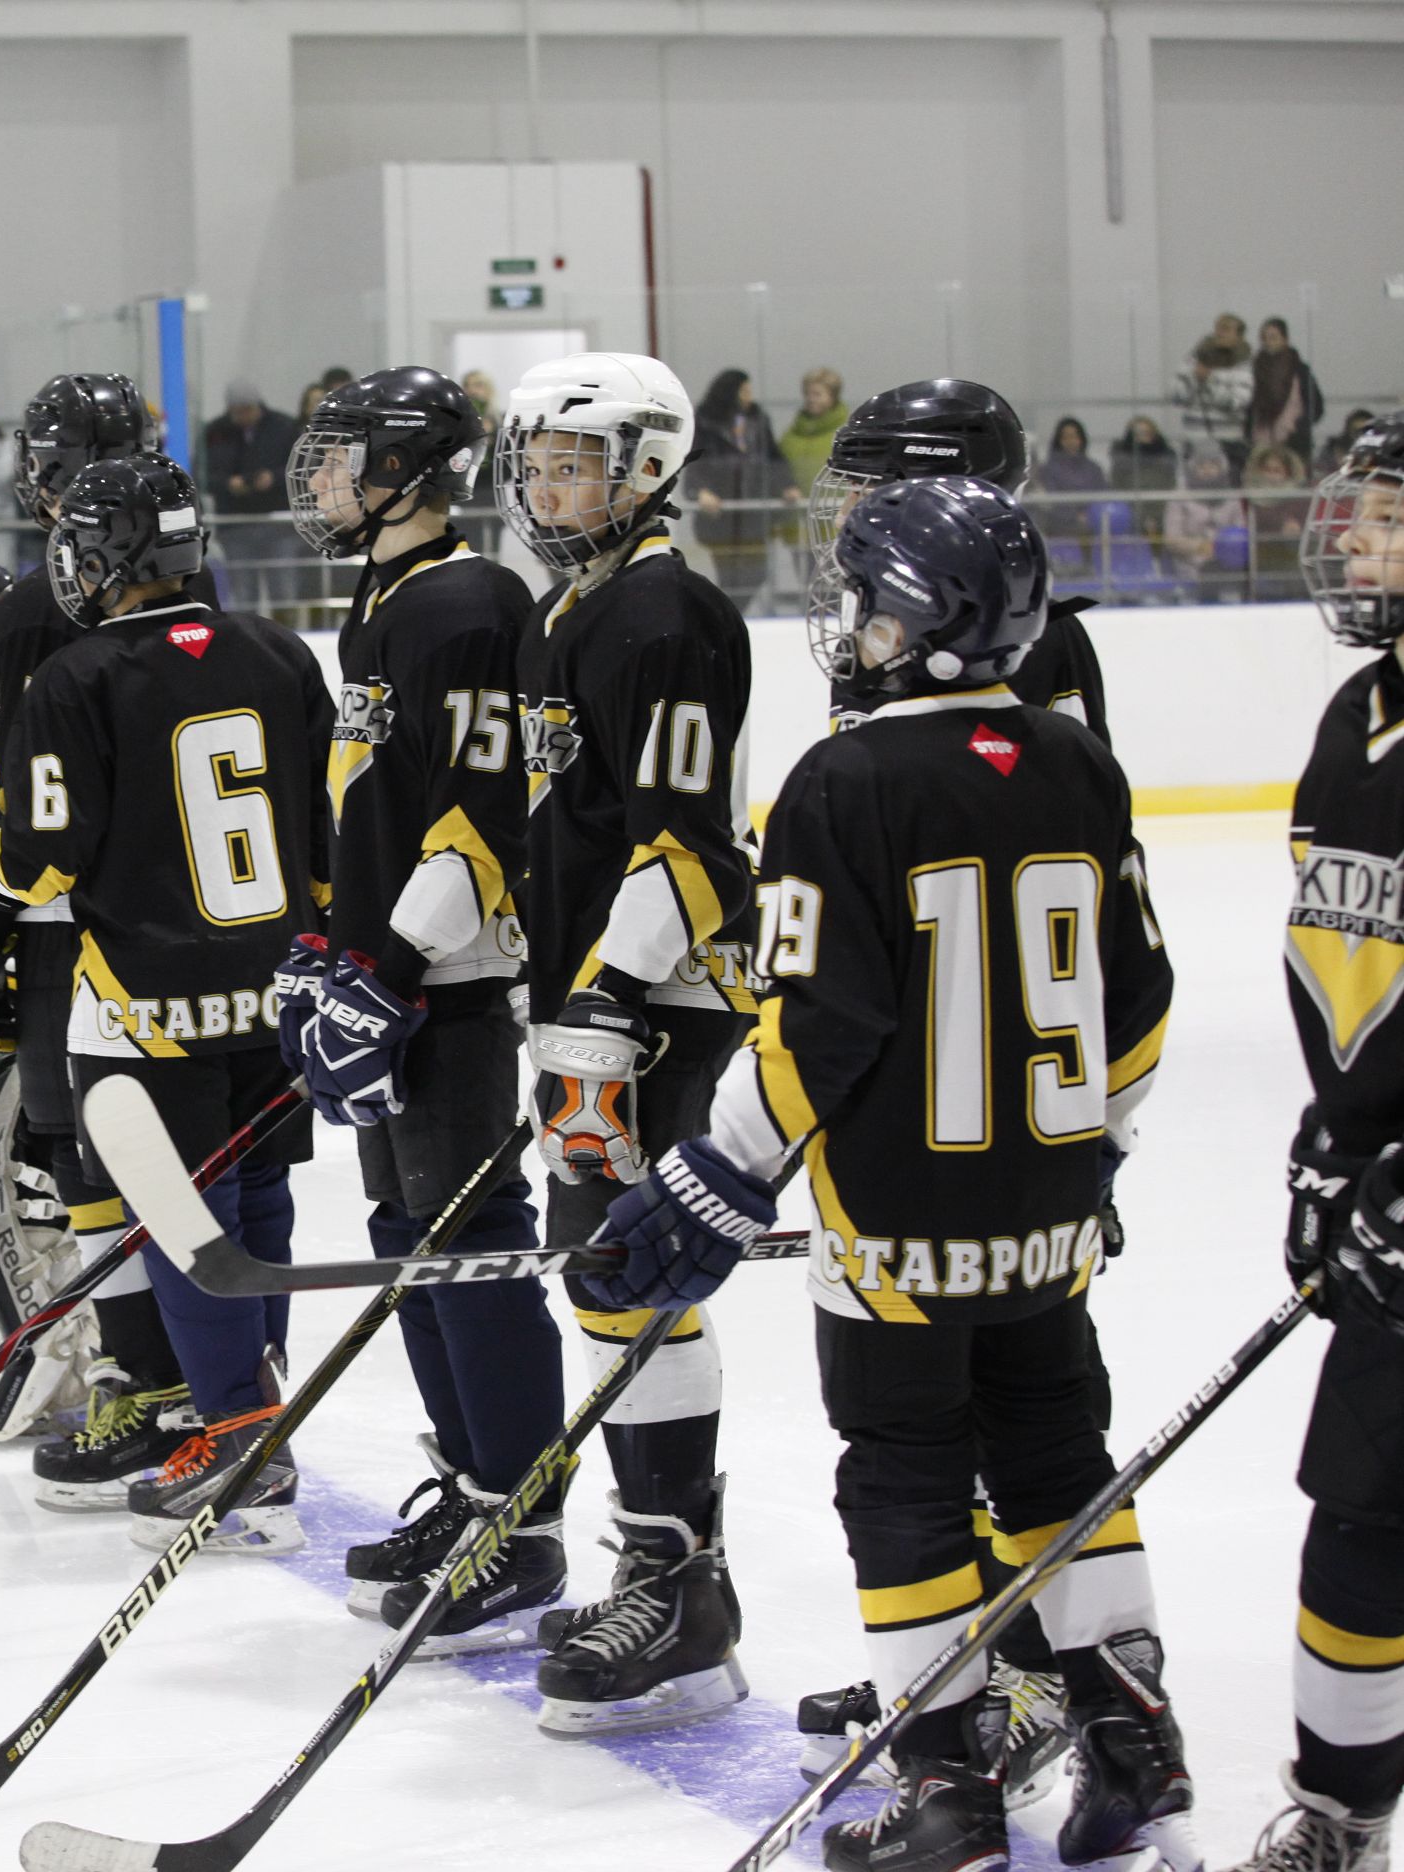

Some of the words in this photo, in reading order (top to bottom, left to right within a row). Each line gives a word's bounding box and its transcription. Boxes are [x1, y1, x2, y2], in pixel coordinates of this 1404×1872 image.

[384, 419, 427, 427] BAUER
[904, 445, 959, 458] BAUER
[881, 570, 933, 604] BAUER
[170, 628, 209, 644] STOP
[444, 688, 511, 773] 15
[635, 698, 714, 793] 10
[971, 740, 1014, 754] STOP
[30, 753, 69, 830] 6
[171, 707, 288, 926] 6
[756, 875, 823, 978] 19
[97, 983, 281, 1040] СТАВРО
[316, 989, 389, 1039] UER
[907, 852, 1108, 1152] 19
[393, 1253, 571, 1287] CCM
[1146, 1357, 1238, 1457] BAUER
[448, 1440, 570, 1601] BAUER
[98, 1504, 220, 1659] BAUER
[6, 1717, 45, 1762] S180
